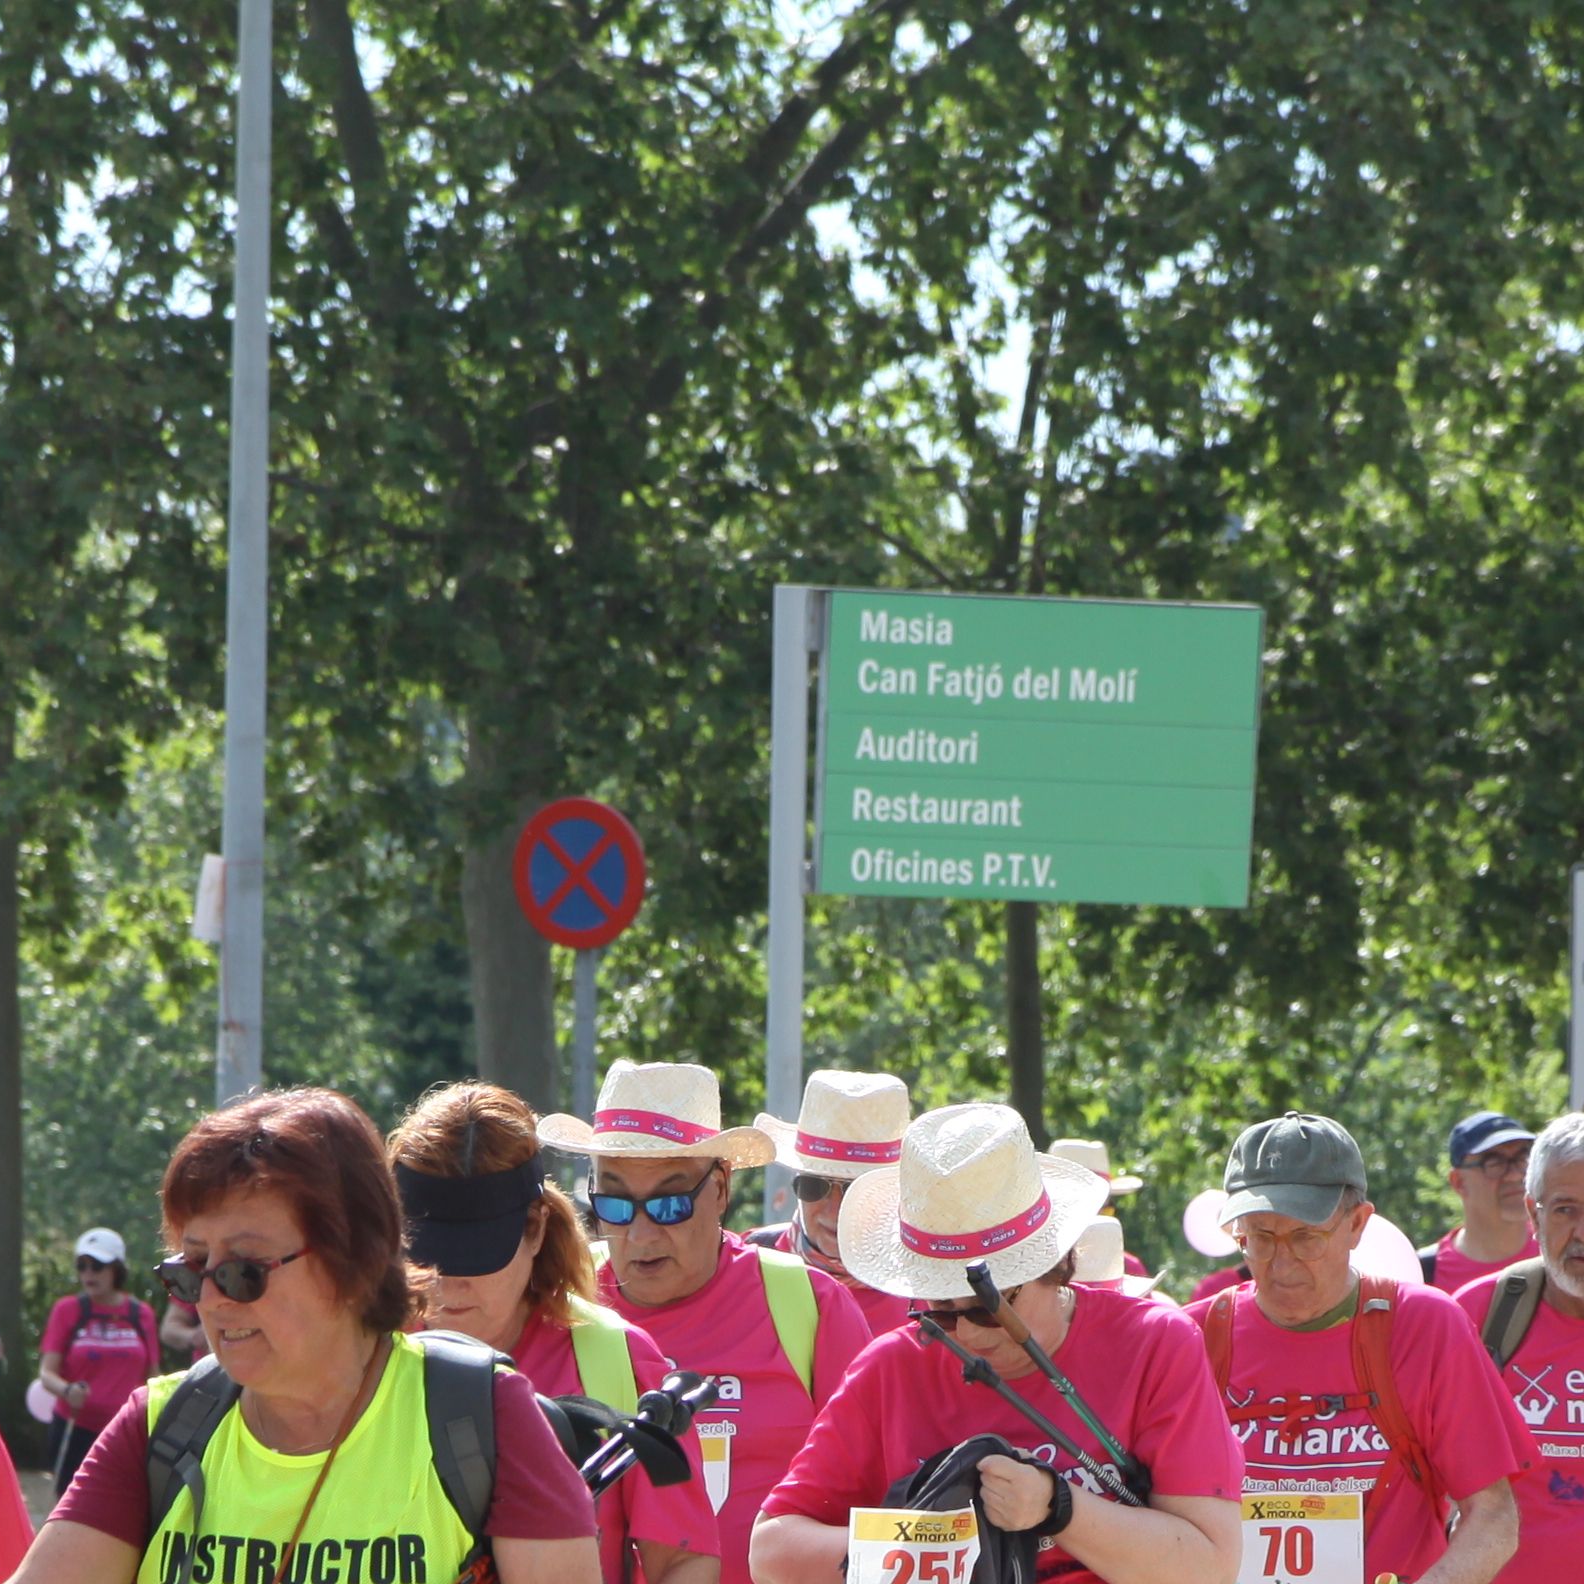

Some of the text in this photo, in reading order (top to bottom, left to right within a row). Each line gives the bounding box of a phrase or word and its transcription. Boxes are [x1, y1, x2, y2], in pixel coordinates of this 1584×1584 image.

[860, 610, 954, 646] Masia
[857, 660, 1139, 705] Can Fatjó del Molí
[855, 727, 979, 764] Auditori
[852, 788, 1022, 828] Restaurant
[851, 848, 1056, 889] Oficines P.T.V.
[1264, 1424, 1391, 1456] marxa
[1267, 1500, 1291, 1509] eco
[1267, 1510, 1306, 1519] marxa
[915, 1522, 944, 1532] eco
[915, 1532, 957, 1543] marxa
[1259, 1525, 1314, 1577] 70
